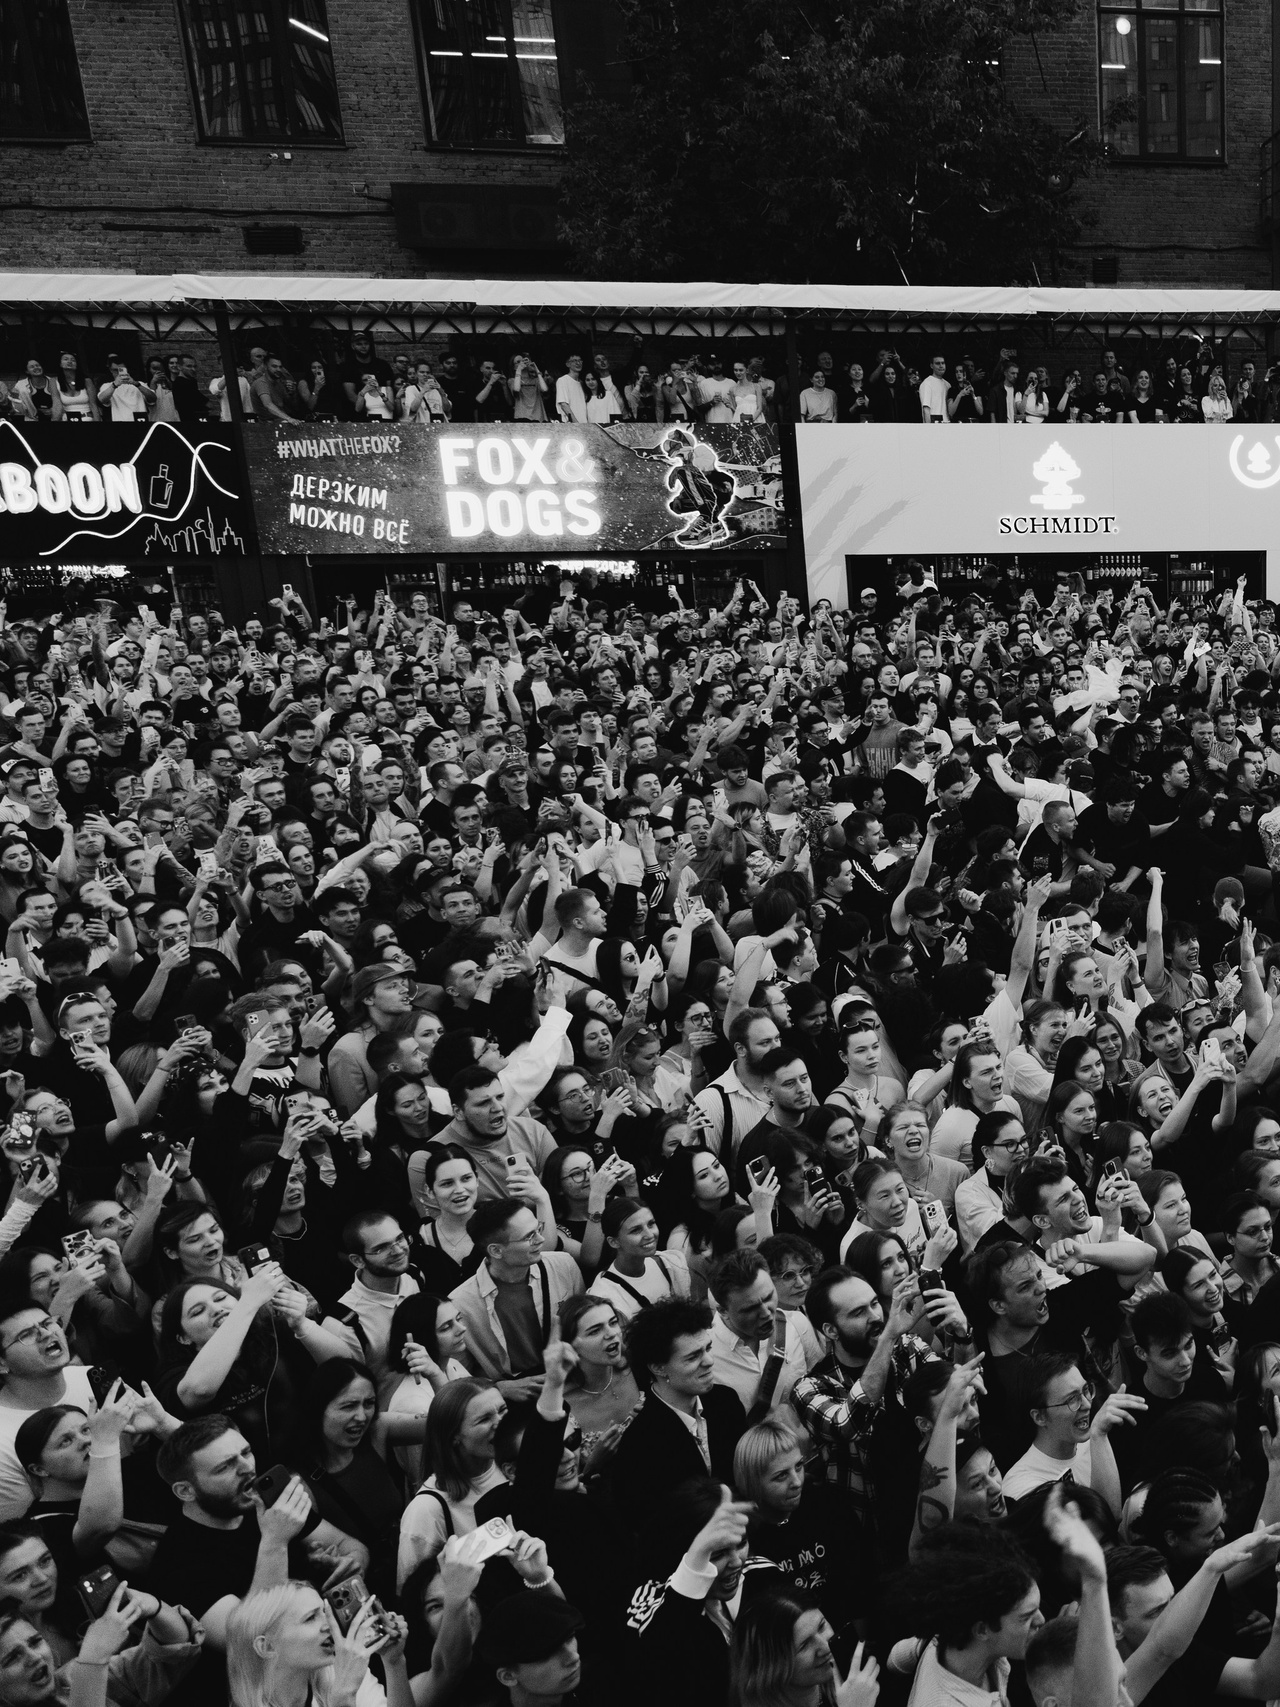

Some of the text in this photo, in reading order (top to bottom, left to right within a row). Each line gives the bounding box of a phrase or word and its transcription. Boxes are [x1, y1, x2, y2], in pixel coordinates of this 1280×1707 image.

[277, 435, 401, 459] #WHATTHEFOX?
[0, 462, 142, 514] BOON
[290, 474, 387, 511] ДЕРЗКИМ
[290, 502, 410, 544] МОЖНО ВСЁ
[445, 490, 602, 537] DOGS
